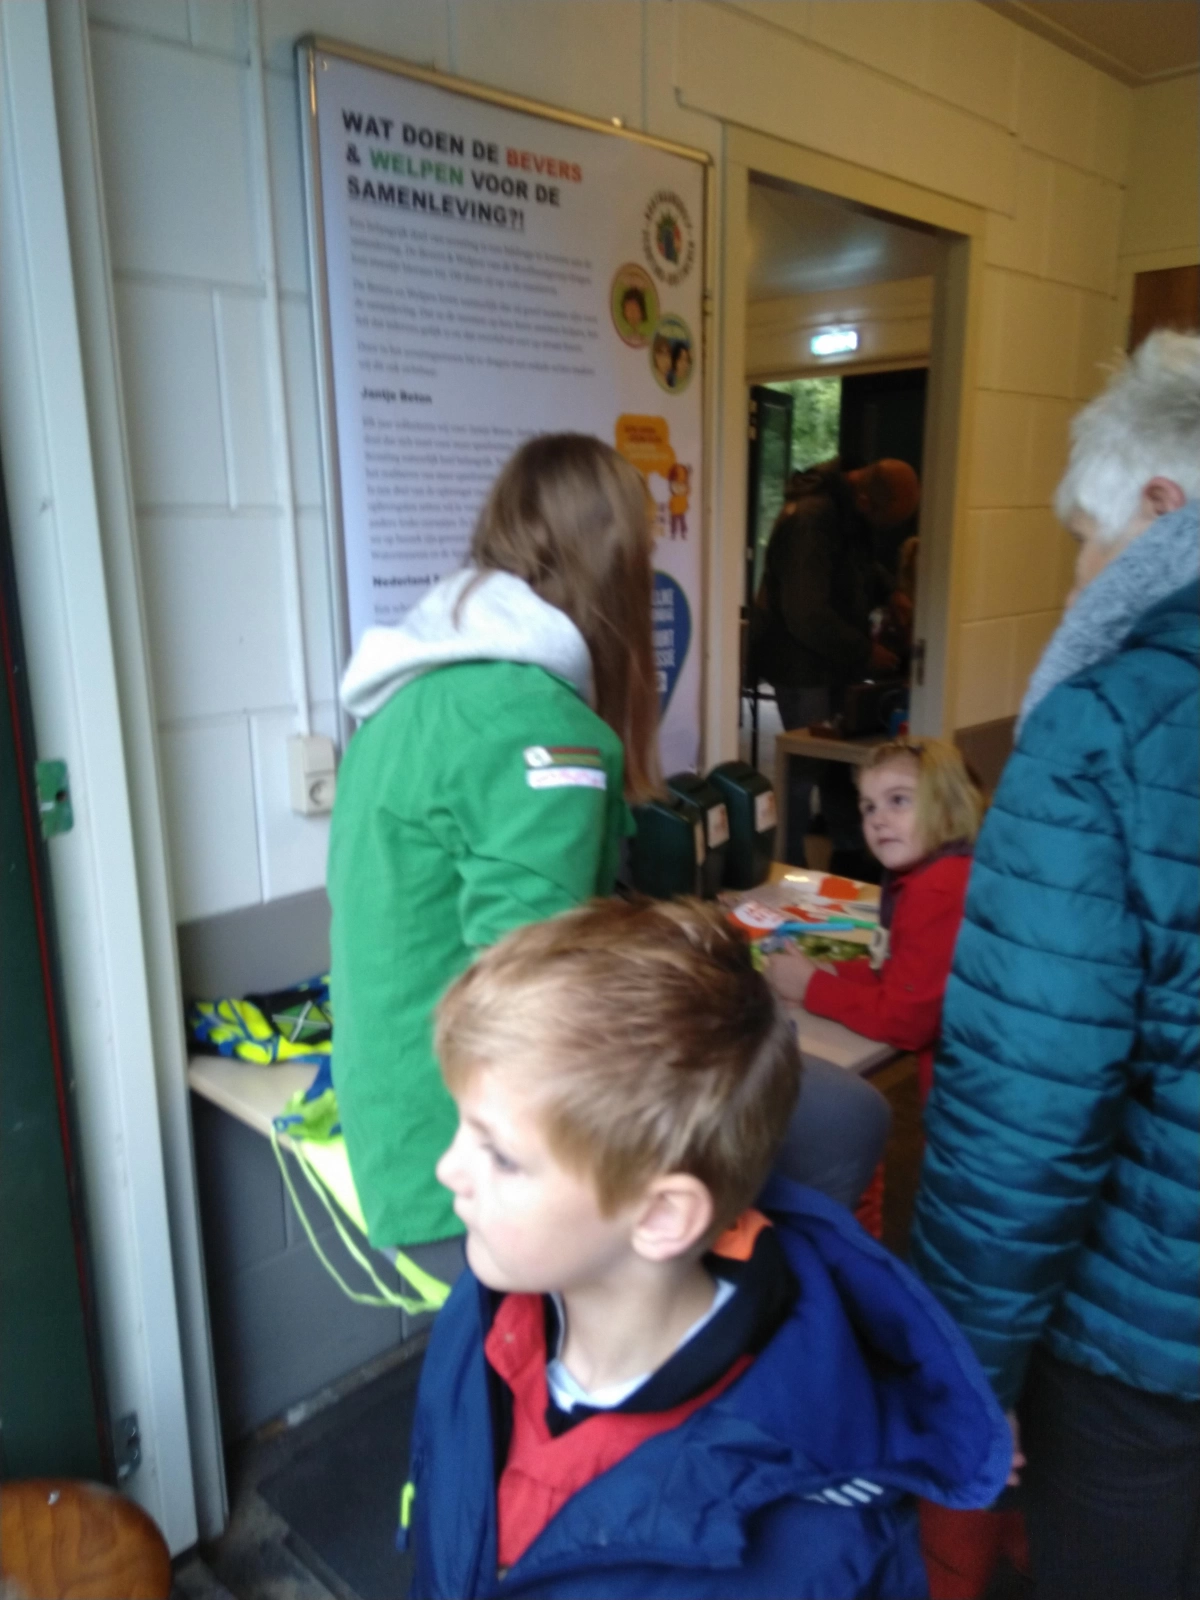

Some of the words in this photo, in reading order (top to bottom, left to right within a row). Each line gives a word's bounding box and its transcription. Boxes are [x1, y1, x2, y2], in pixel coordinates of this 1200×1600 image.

[342, 108, 393, 141] WAT
[402, 121, 464, 156] DOEN
[472, 138, 499, 164] DE
[506, 147, 582, 183] BEVERS
[346, 143, 361, 166] &
[369, 147, 464, 186] WELPEN
[471, 170, 528, 201] VOOR
[536, 185, 560, 207] DE
[347, 175, 525, 229] SAMENLEVING?!
[373, 574, 430, 588] Nederland
